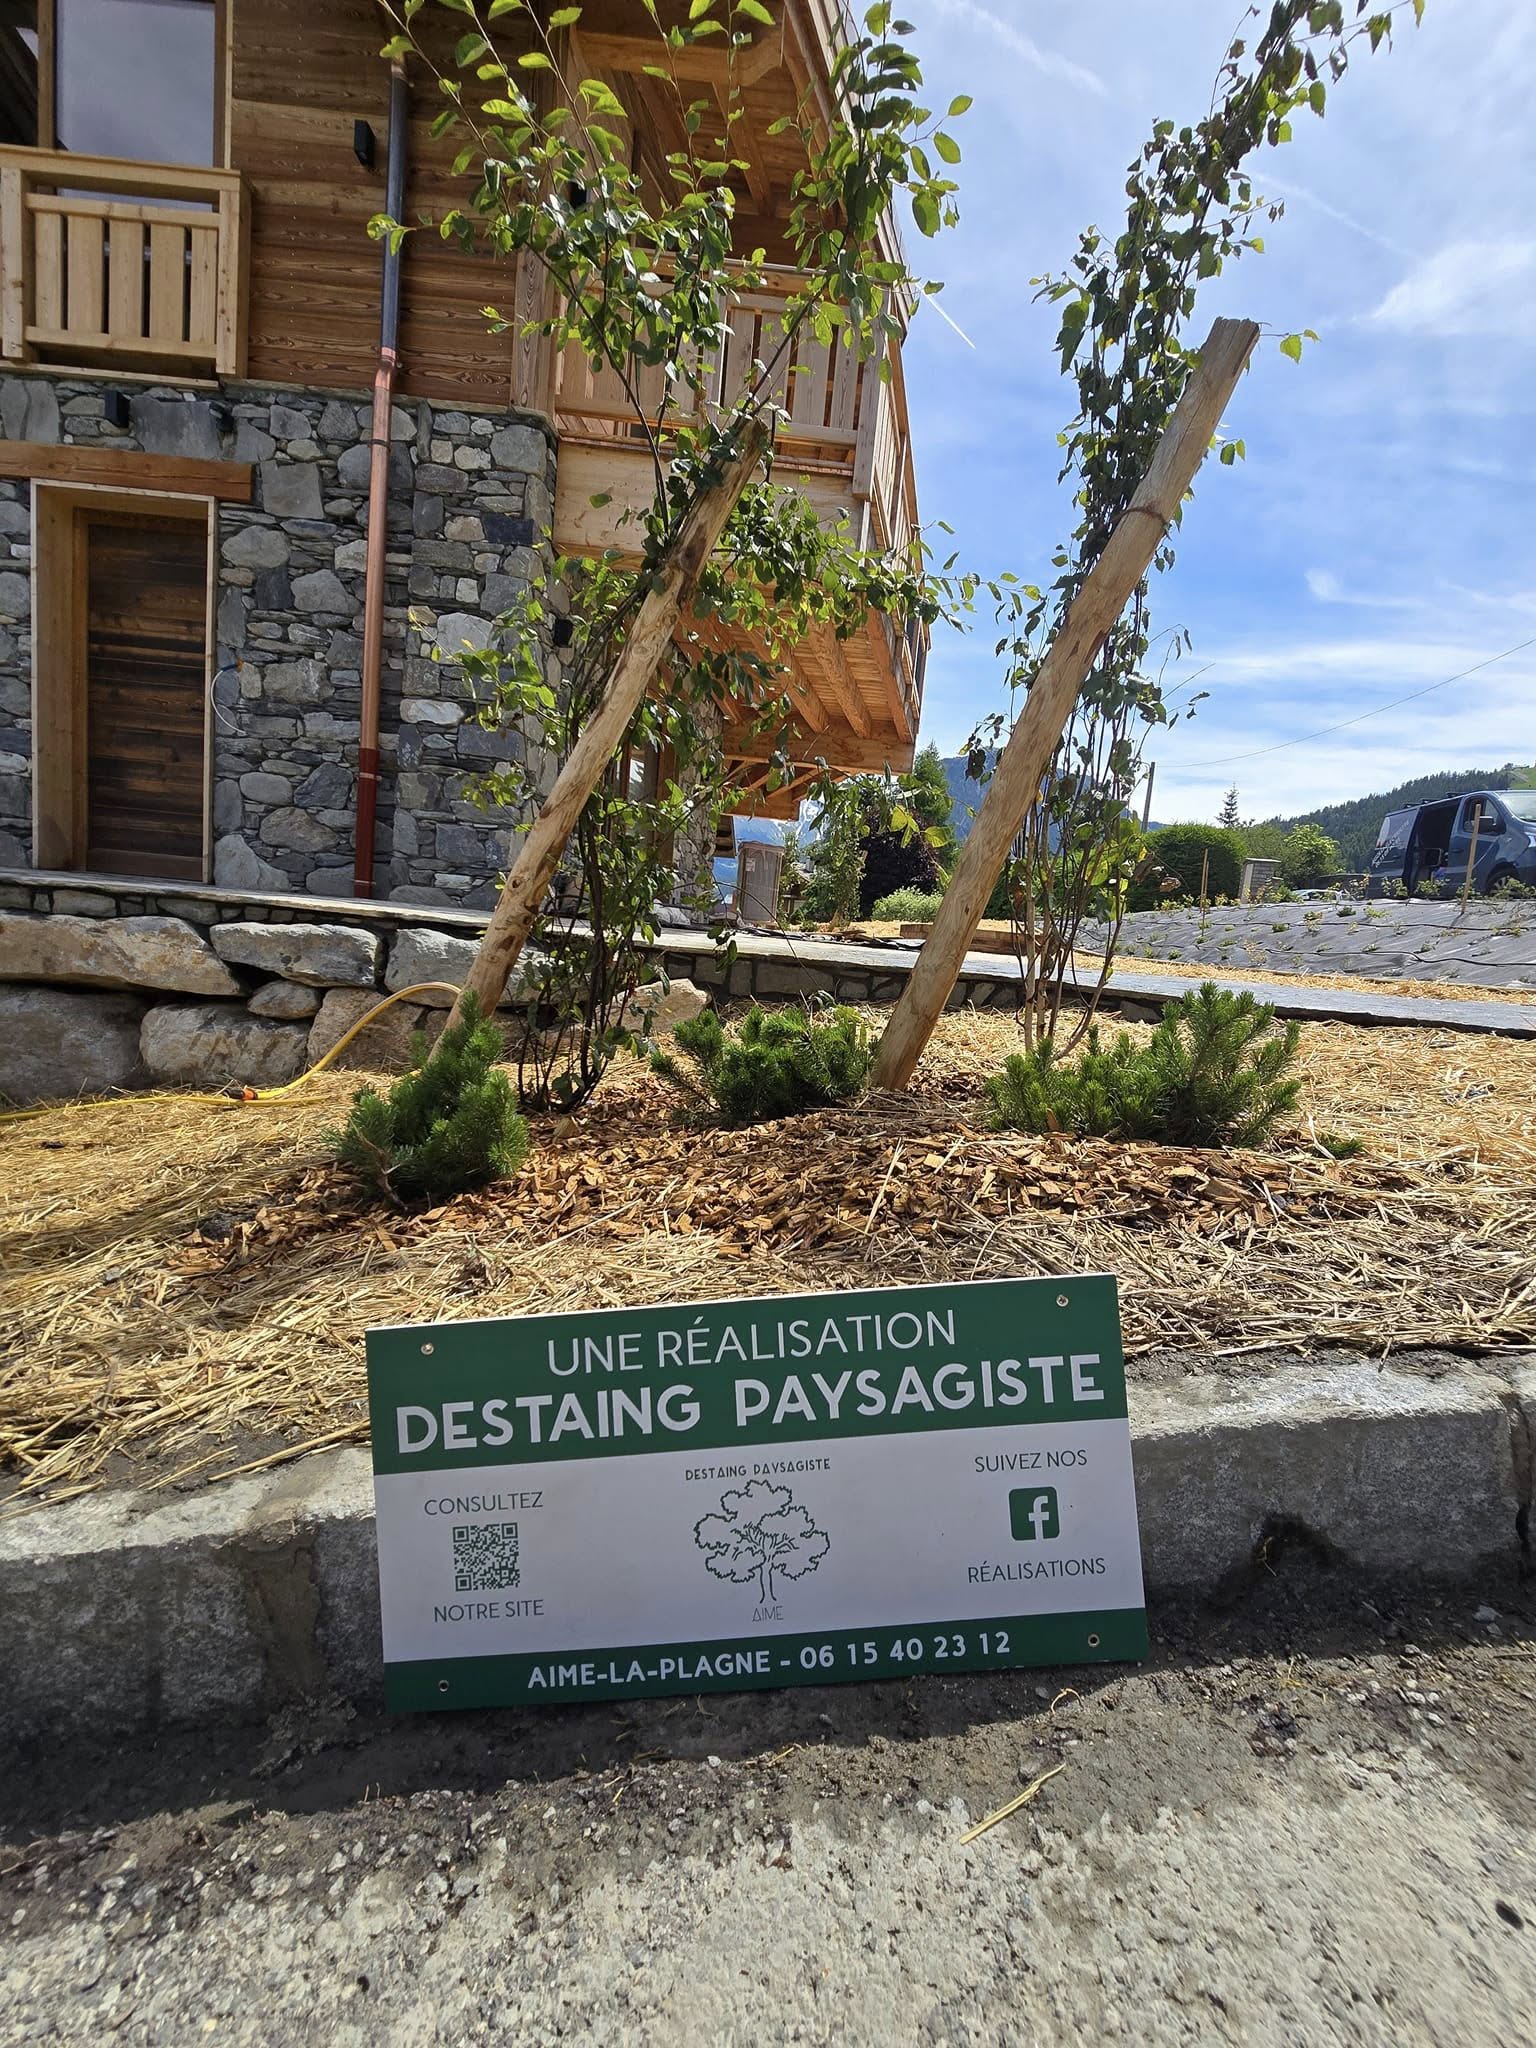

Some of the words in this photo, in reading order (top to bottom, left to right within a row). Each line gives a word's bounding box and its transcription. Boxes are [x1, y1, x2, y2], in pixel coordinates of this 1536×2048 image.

[548, 1333, 643, 1376] UNE
[657, 1309, 956, 1368] RÉALISATION
[396, 1384, 701, 1454] DESTAING
[734, 1353, 1105, 1427] PAYSAGISTE
[685, 1465, 747, 1481] DESTAING
[974, 1452, 1042, 1473] SUIVEZ
[1047, 1449, 1088, 1468] NOS
[424, 1490, 544, 1516] CONSULTEZ
[968, 1557, 1106, 1583] RÉALISATIONS
[434, 1602, 500, 1623] NOTRE
[505, 1599, 545, 1618] SITE
[752, 1605, 784, 1622] AIME
[527, 1650, 771, 1689] AIME-LA-PLAGNE
[800, 1645, 835, 1669] 06
[847, 1641, 878, 1665] 15
[890, 1638, 924, 1661] 40
[933, 1634, 967, 1658] 23
[979, 1631, 1010, 1655] 12
